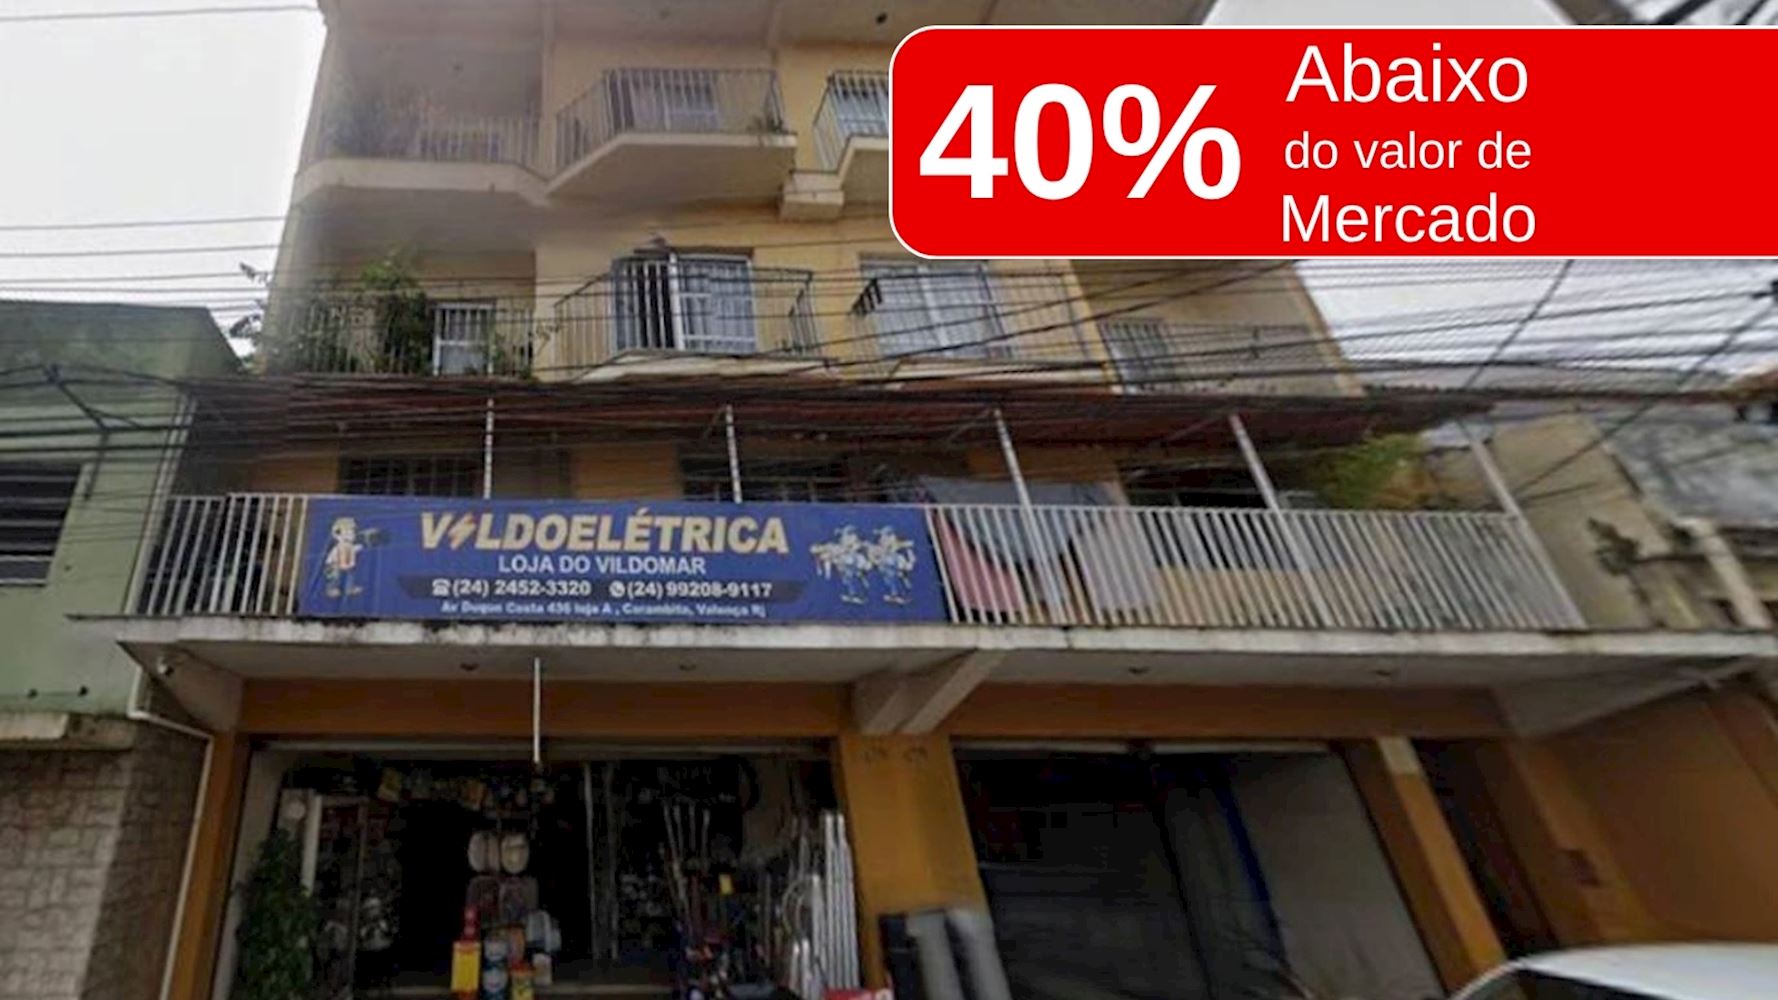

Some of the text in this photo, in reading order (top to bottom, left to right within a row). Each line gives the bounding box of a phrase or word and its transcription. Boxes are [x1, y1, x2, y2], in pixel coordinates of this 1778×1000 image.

[498, 556, 706, 575] LOJA DO VILDOMAR
[452, 579, 592, 597] (24) 2452-3320
[627, 580, 773, 599] (24) 99208-9117
